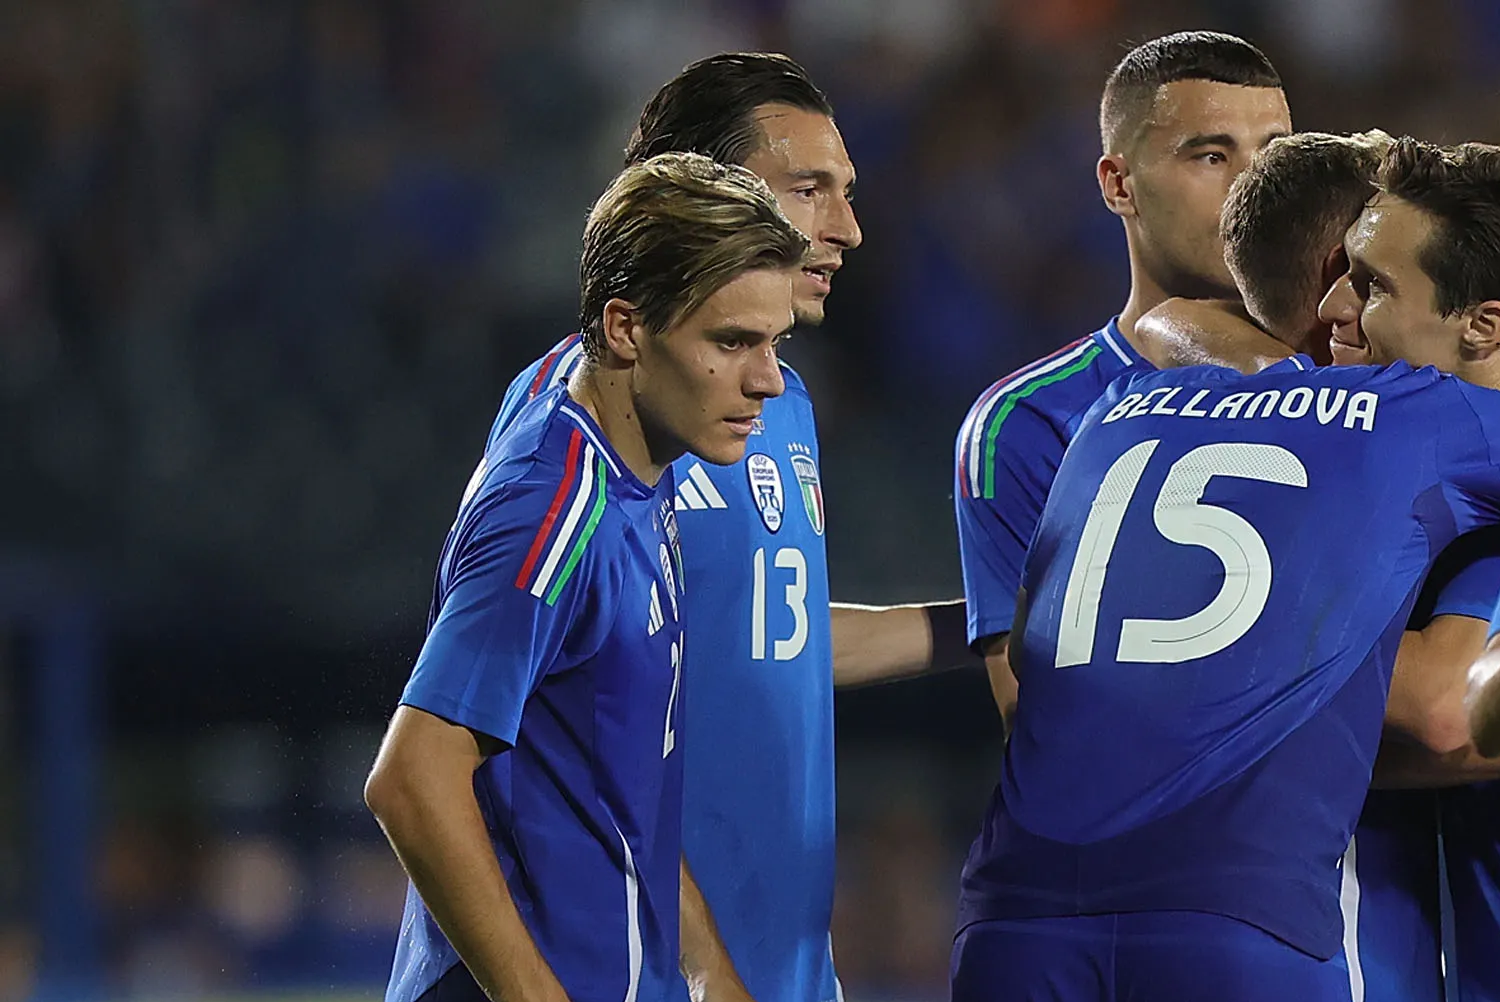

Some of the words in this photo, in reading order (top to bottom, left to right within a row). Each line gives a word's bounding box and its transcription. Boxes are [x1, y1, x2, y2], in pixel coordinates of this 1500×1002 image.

[1102, 386, 1379, 432] BELLANOVA
[752, 547, 809, 661] 13
[1054, 439, 1309, 668] 15
